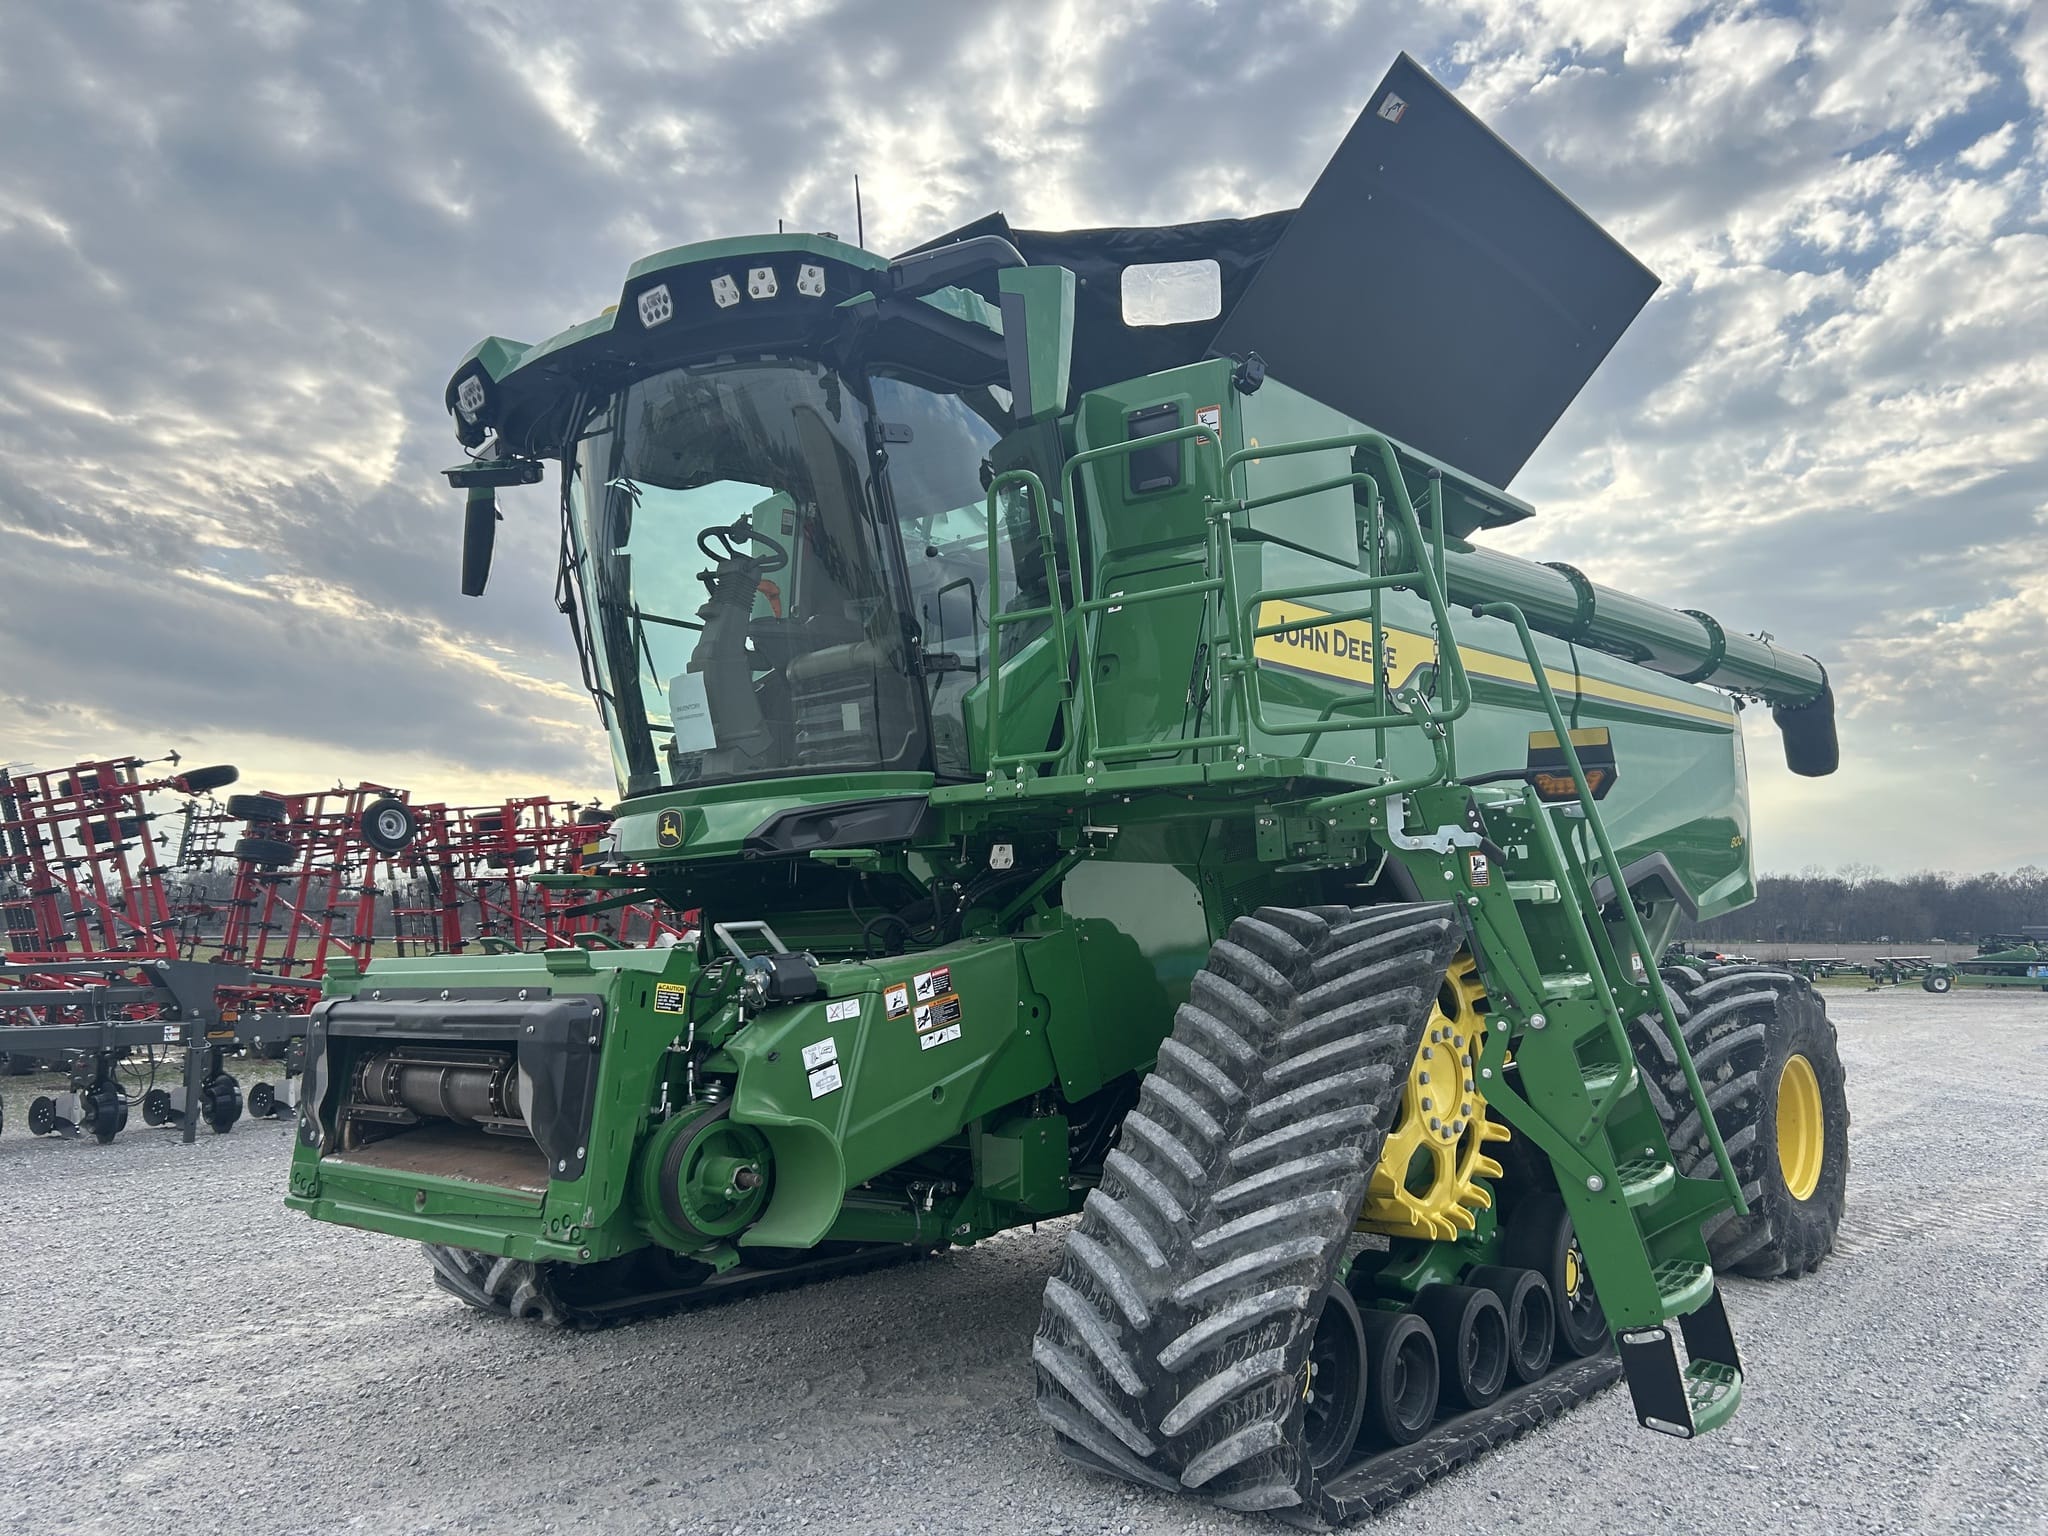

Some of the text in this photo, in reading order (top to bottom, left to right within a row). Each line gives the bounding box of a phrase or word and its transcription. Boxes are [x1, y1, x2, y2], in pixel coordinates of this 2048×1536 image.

[1273, 615, 1398, 669] JOHN DEEE
[662, 984, 685, 992] CAUTION
